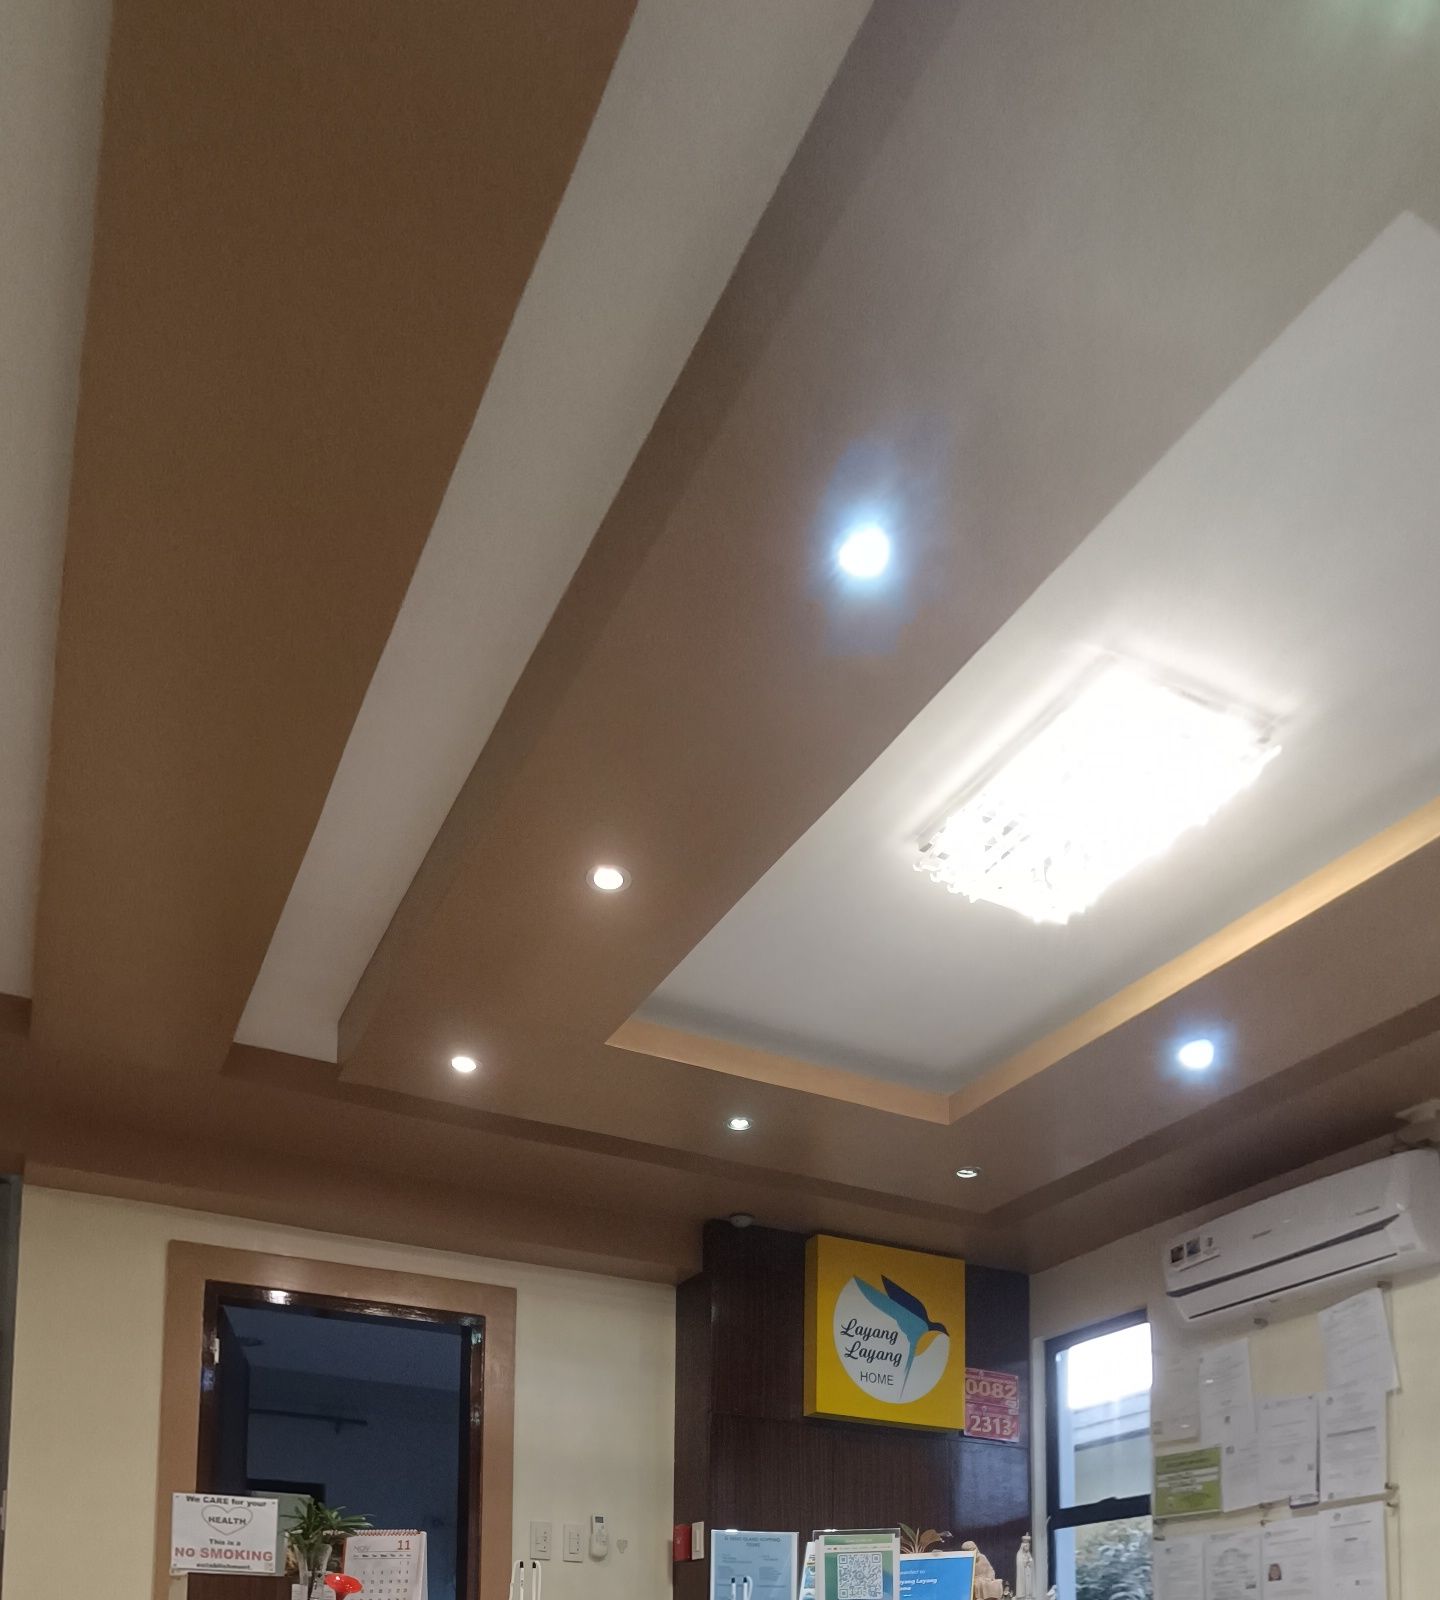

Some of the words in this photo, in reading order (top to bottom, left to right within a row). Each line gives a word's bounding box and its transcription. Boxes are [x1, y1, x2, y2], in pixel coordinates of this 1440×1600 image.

[840, 1318, 899, 1345] Layang
[844, 1340, 903, 1367] Layang
[860, 1371, 894, 1386] HOME
[966, 1379, 1017, 1400] 0082
[970, 1415, 1014, 1436] 2313
[203, 1496, 229, 1504] CARE
[208, 1516, 247, 1525] HEALTH
[397, 1540, 411, 1550] 11
[174, 1547, 195, 1557] NO
[199, 1547, 273, 1561] SMOKING
